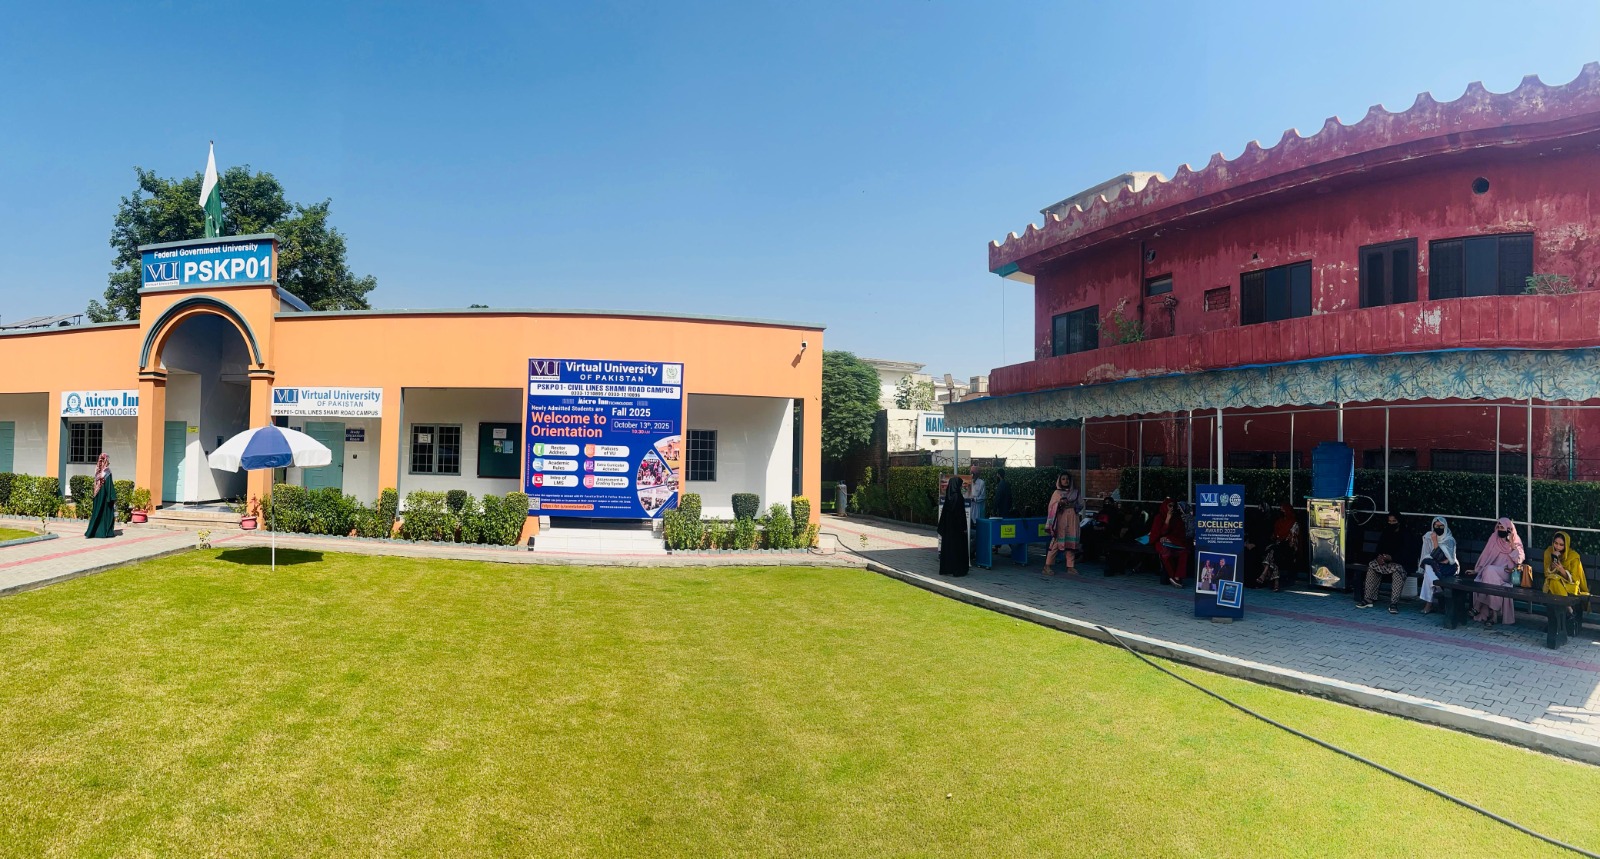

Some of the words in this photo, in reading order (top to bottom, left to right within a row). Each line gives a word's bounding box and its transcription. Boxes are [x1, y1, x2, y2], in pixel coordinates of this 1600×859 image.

[154, 251, 178, 259] Federal
[180, 246, 220, 257] Government
[222, 243, 258, 252] University
[184, 256, 270, 282] PSKP01
[566, 362, 602, 372] Virtual
[604, 363, 658, 376] University
[596, 374, 644, 382] PAKISTAN
[84, 392, 118, 407] Micro
[302, 390, 331, 400] Virtual
[334, 390, 380, 402] University
[531, 412, 590, 425] Welcome
[594, 413, 607, 425] to
[612, 408, 626, 416] Fall
[629, 408, 650, 417] 2025
[531, 425, 603, 438] Orientation
[614, 421, 638, 429] October
